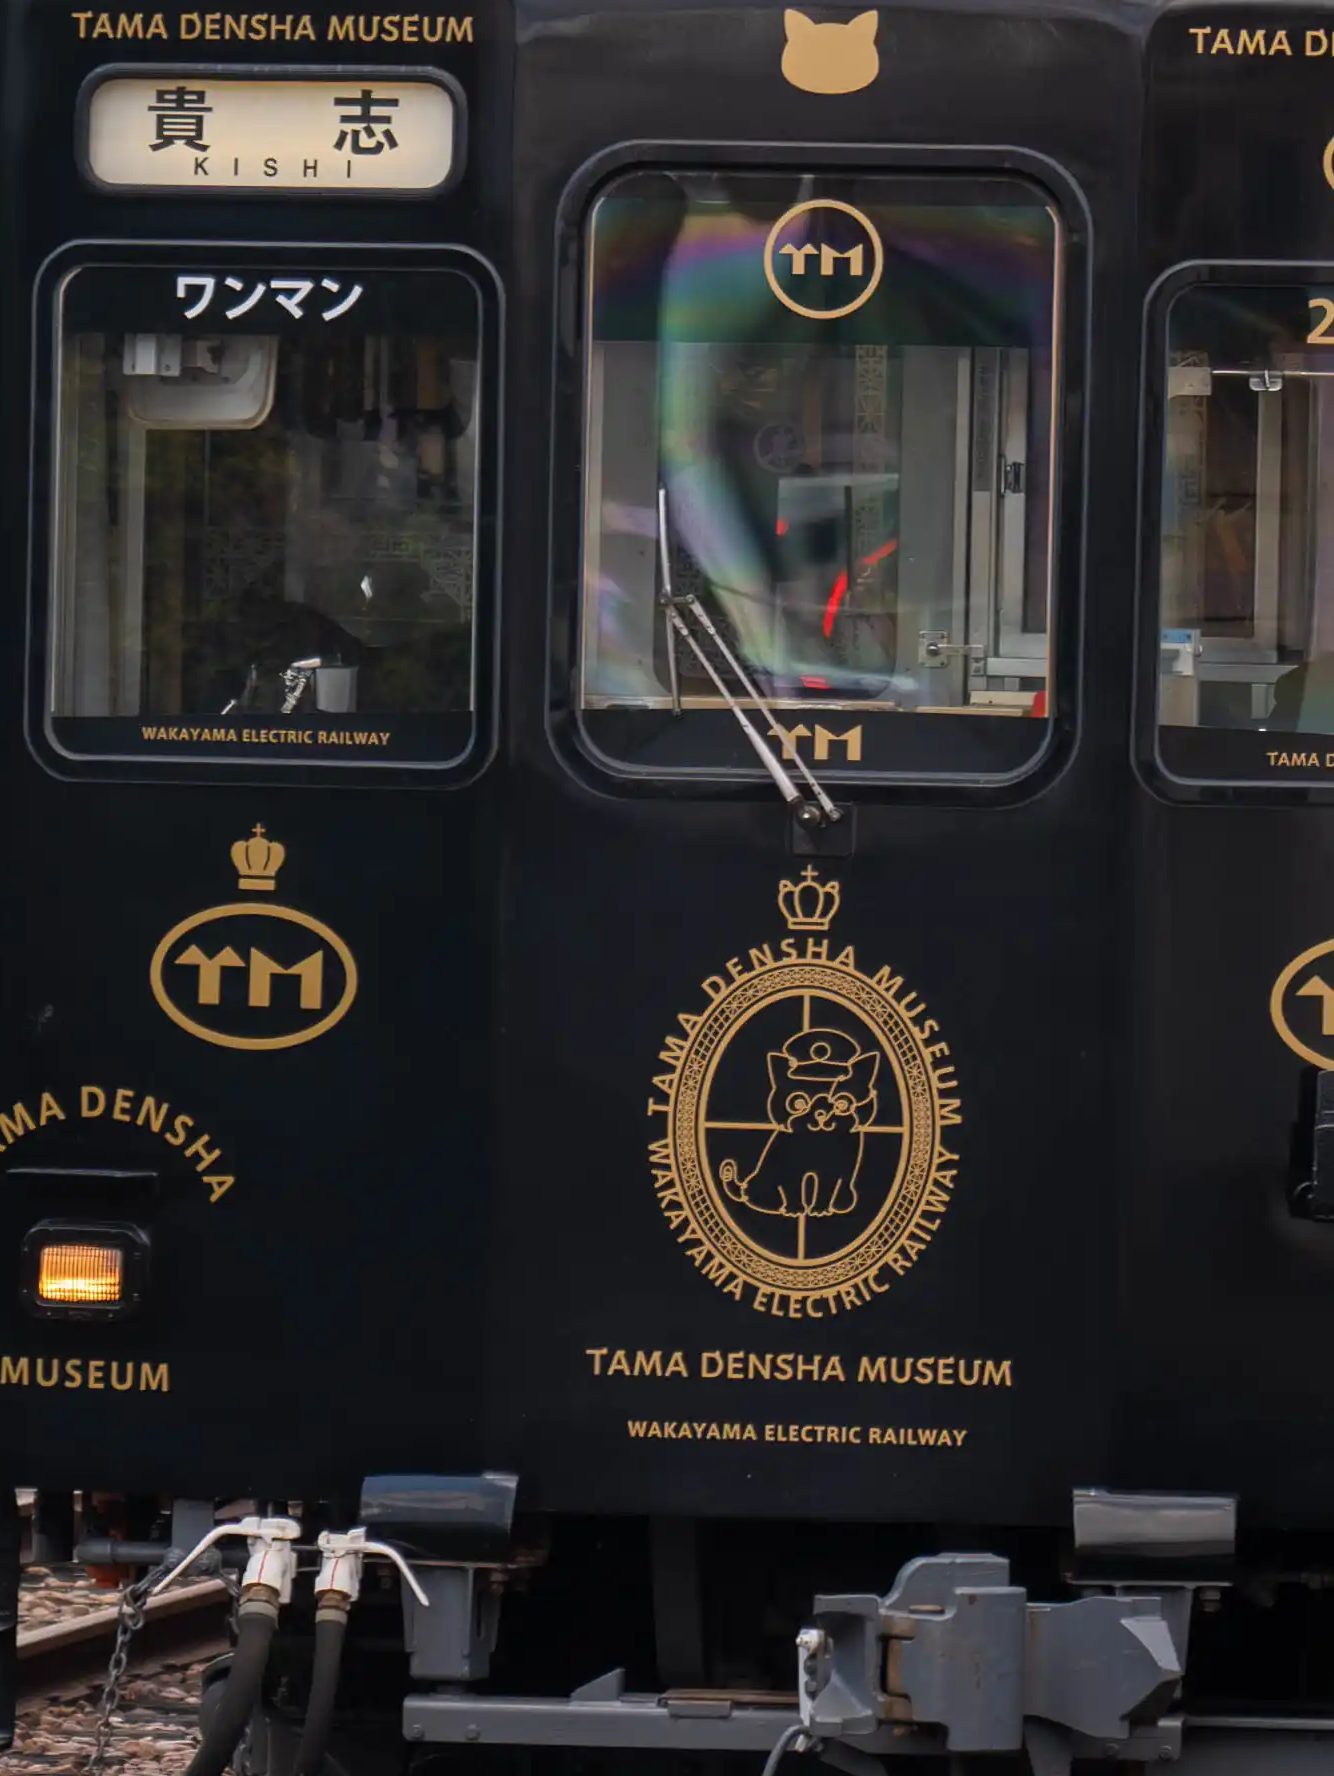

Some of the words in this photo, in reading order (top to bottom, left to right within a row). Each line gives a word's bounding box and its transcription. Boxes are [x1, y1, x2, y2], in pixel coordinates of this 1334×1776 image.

[72, 11, 168, 40] TAMA
[180, 12, 316, 41] DENSHA
[327, 15, 474, 43] MUSEUM
[1188, 27, 1293, 57] TAMA
[147, 86, 400, 156] 貴志
[193, 157, 352, 179] KISHI
[175, 275, 364, 323] ワンマン
[141, 726, 238, 742] WAKAYAMA
[241, 729, 312, 744] ELECTRIC
[317, 730, 391, 746] RAILWAY
[1266, 751, 1320, 767] TAMA
[646, 1012, 703, 1117] TAMA
[701, 937, 857, 1002] DENSHA
[870, 964, 962, 1126] MUSEUM
[80, 1085, 236, 1204] DENSHA
[648, 1138, 745, 1302] WAKAYAMA
[752, 1269, 891, 1319] ELECTRIC
[883, 1144, 961, 1276] RAILWAY
[0, 1357, 170, 1392] MUSEUM
[586, 1347, 688, 1377] TAMA
[700, 1350, 846, 1382] DENSHA
[857, 1356, 1012, 1387] MUSEUM
[627, 1421, 757, 1441] WAKAYAMA
[764, 1424, 861, 1444] ELECTRIC
[868, 1427, 967, 1447] RAILWAY
